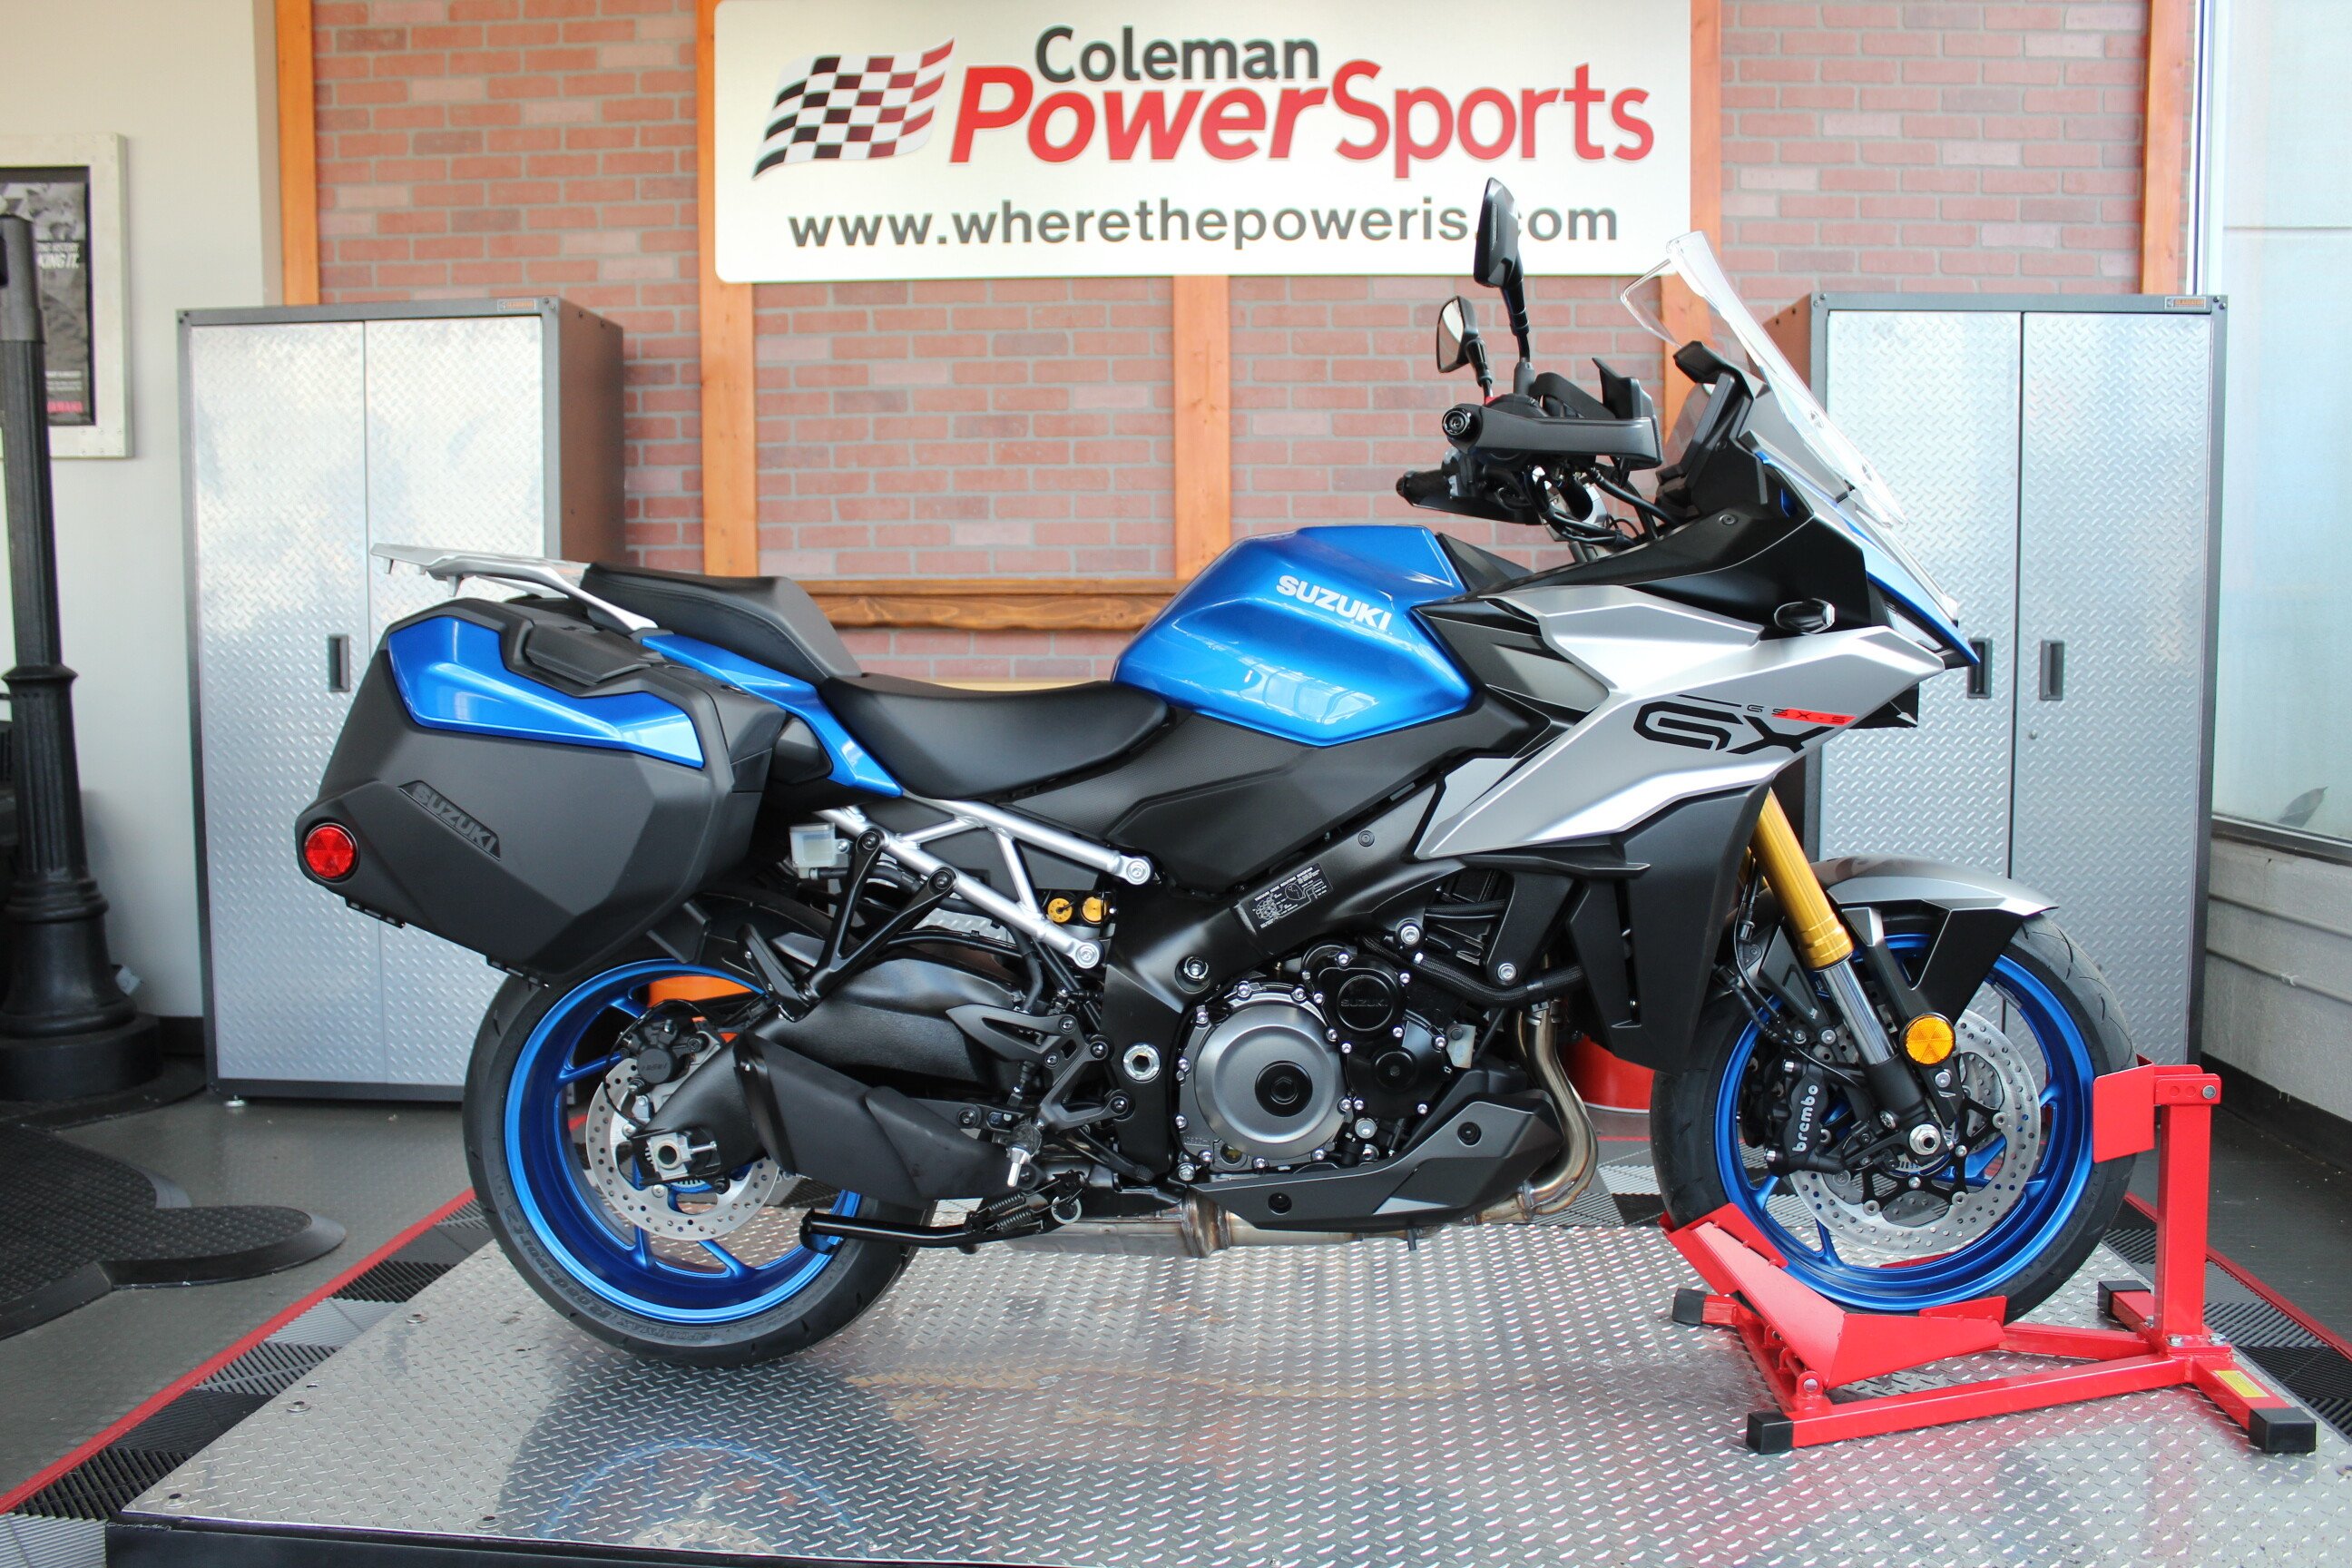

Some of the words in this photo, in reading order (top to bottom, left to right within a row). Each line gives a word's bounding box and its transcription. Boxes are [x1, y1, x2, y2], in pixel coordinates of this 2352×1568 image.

[1035, 24, 1319, 83] Coleman
[949, 59, 1654, 179] PowerSports
[789, 197, 1618, 250] www.wherethepowerisom
[1276, 575, 1392, 631] SUZUKI
[1747, 704, 1846, 724] GSX-S
[413, 784, 496, 851] SUZUKI
[1792, 1084, 1818, 1152] brembo
